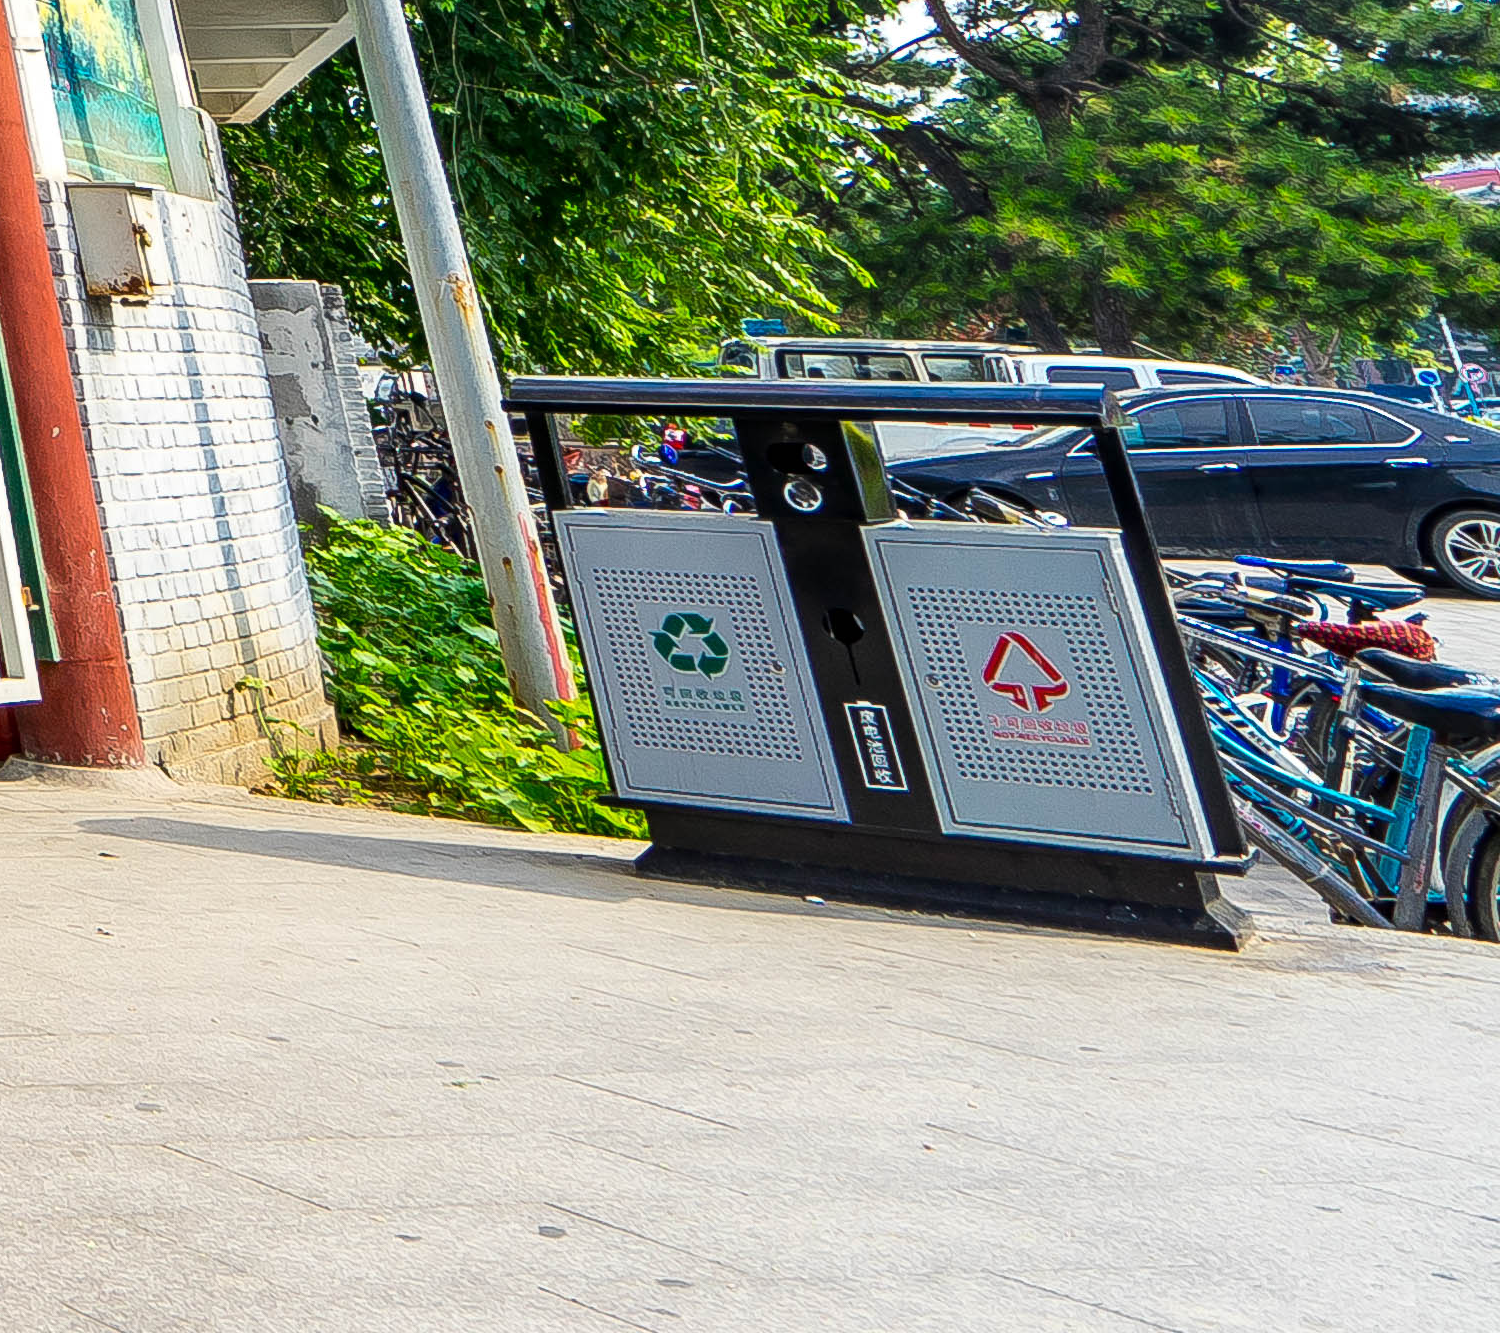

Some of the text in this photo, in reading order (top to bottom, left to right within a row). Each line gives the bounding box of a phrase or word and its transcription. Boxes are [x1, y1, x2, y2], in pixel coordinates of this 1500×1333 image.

[859, 710, 896, 785] 废电池回收
